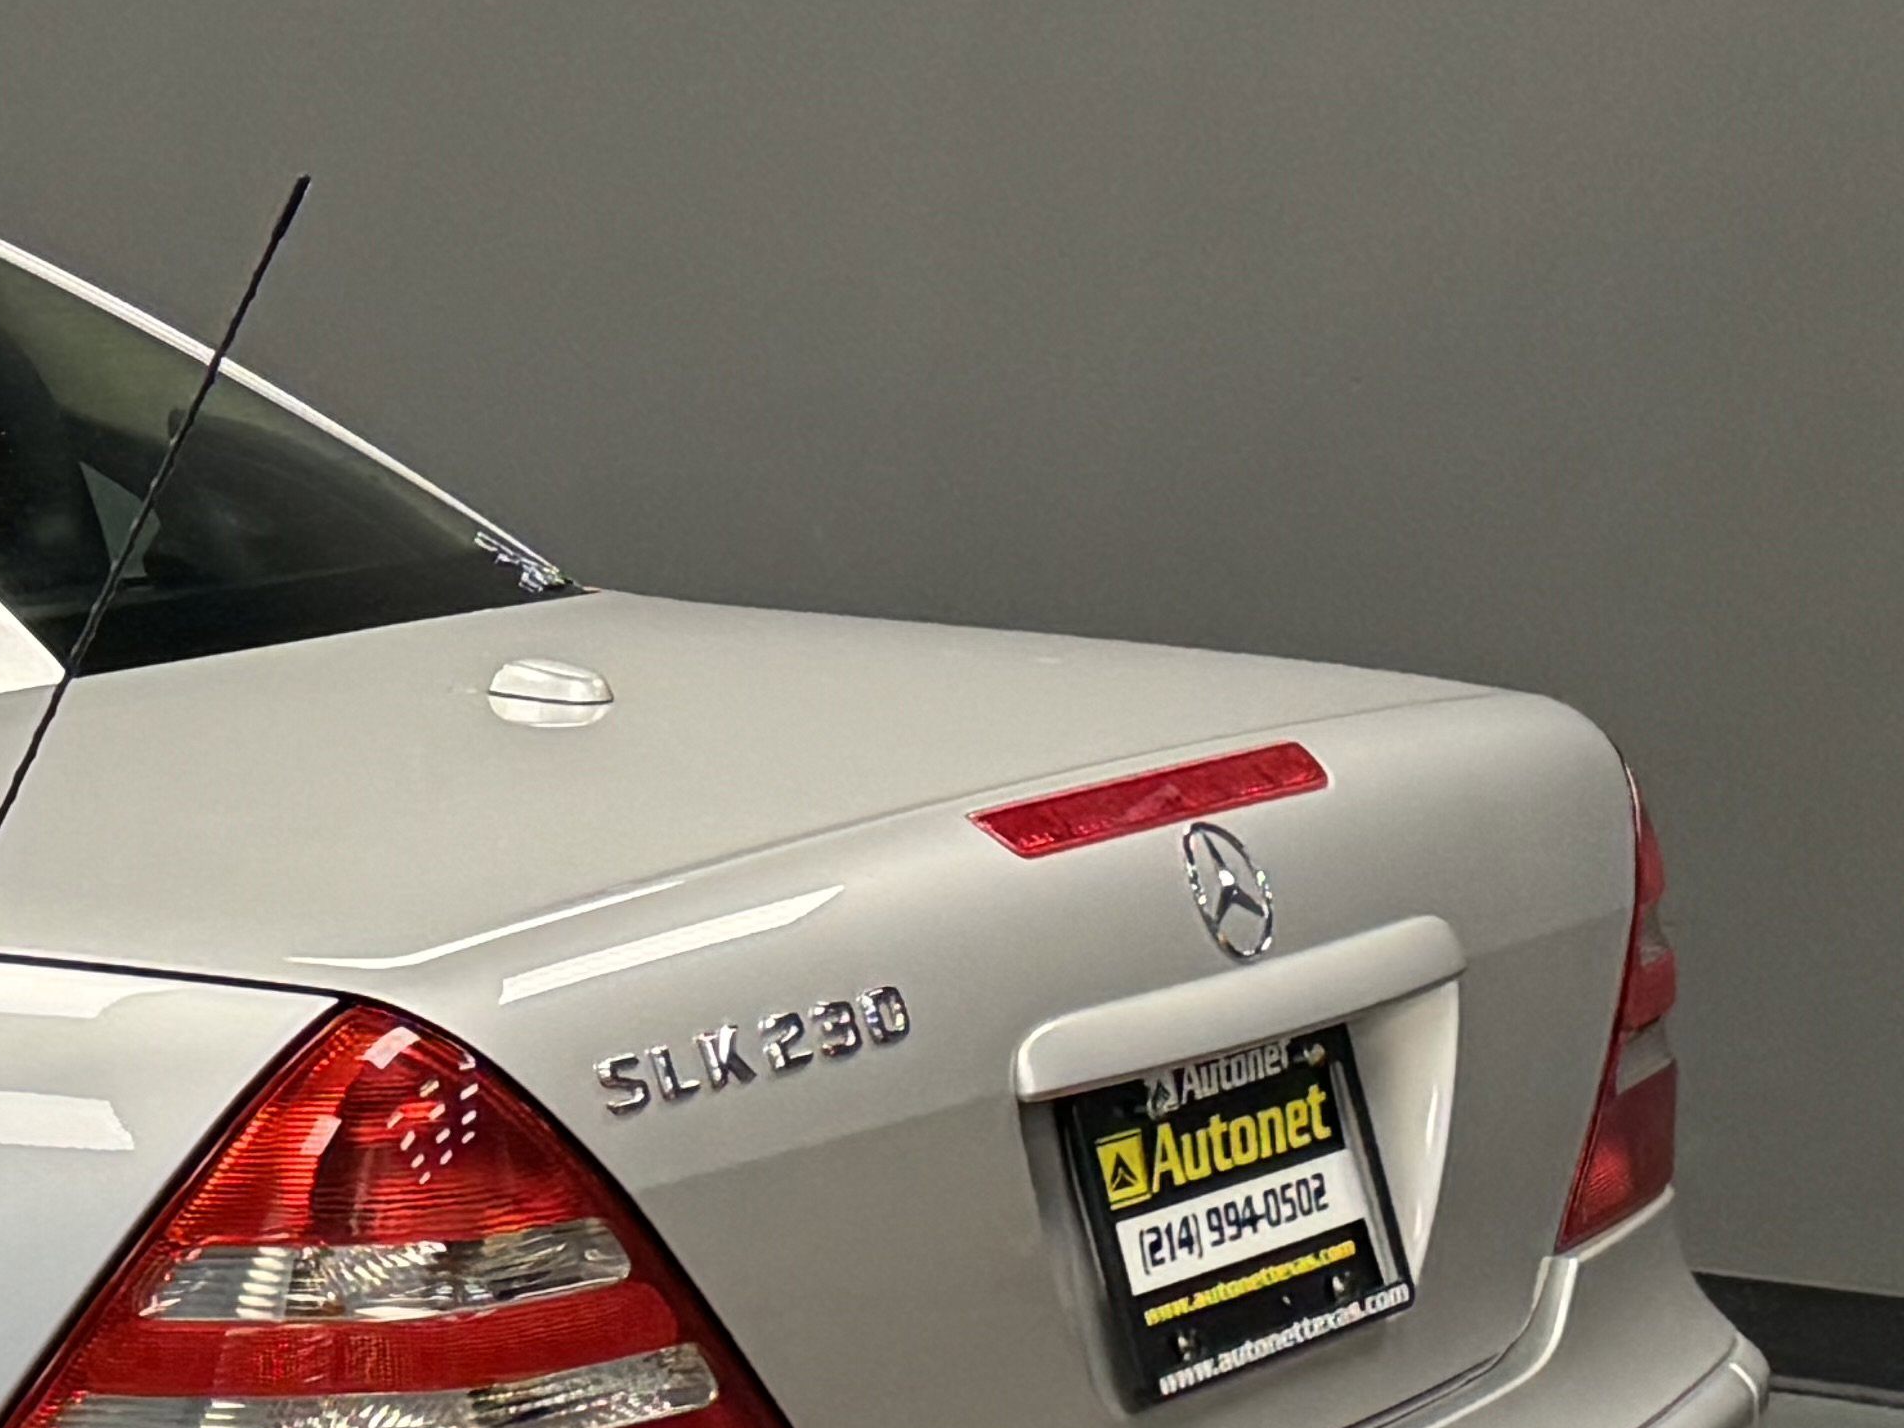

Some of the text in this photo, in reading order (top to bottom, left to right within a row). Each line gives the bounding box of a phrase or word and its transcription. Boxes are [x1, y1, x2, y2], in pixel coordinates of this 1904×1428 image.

[593, 986, 910, 1116] SLK 230
[1181, 1038, 1292, 1106] Autonet
[1152, 1083, 1333, 1193] Autonet
[1138, 1172, 1329, 1275] (214) 994-0502
[1143, 1239, 1357, 1327] www.autonettexas.com
[1158, 1282, 1410, 1396] www.autonettexas.com
